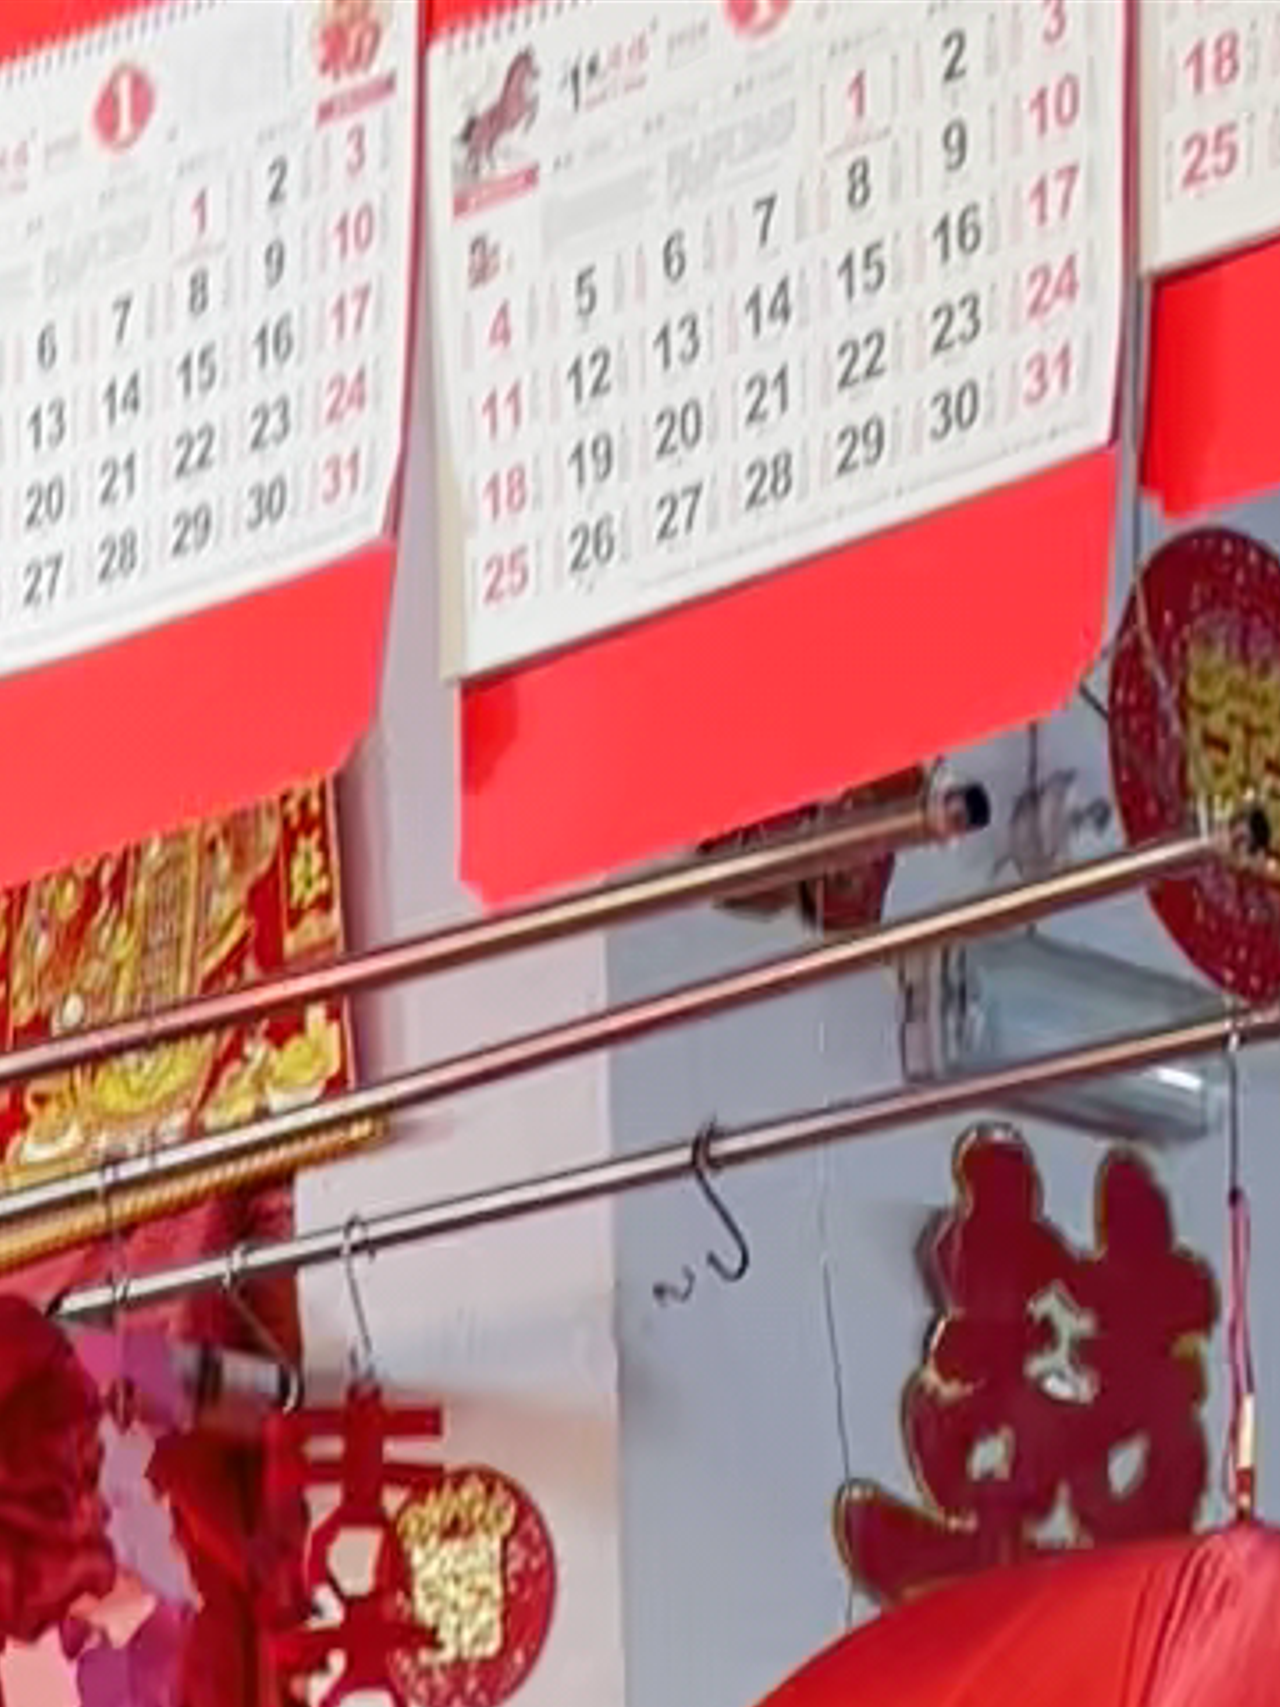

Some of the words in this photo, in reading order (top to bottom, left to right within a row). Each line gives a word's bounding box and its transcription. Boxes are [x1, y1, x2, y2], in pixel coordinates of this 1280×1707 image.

[848, 69, 865, 119] 1
[943, 30, 966, 84] 2
[1043, 0, 1066, 45] 3
[1185, 31, 1240, 95] 18
[192, 188, 206, 235] 1
[268, 156, 287, 208] 2
[347, 124, 366, 179] 3
[489, 300, 511, 349] 4
[576, 265, 597, 323] 5
[663, 231, 686, 283] 6
[754, 194, 777, 247] 7
[847, 157, 870, 210] 8
[942, 119, 967, 172] 9
[1030, 73, 1079, 137] 10
[1182, 122, 1238, 189] 25
[29, 398, 66, 451] 13
[104, 371, 140, 426] 14
[178, 343, 216, 398] 15
[254, 313, 293, 369] 16
[332, 282, 371, 341] 17
[38, 324, 57, 370] 6
[113, 295, 132, 345] 7
[189, 268, 208, 317] 8
[265, 239, 285, 288] 9
[335, 202, 375, 261] 10
[482, 380, 521, 439] 11
[567, 347, 611, 404] 12
[654, 313, 700, 371] 13
[745, 276, 791, 337] 14
[838, 240, 885, 301] 15
[933, 203, 981, 264] 16
[1030, 162, 1079, 226] 17
[26, 476, 64, 530] 20
[100, 451, 135, 505] 21
[175, 423, 215, 479] 22
[250, 395, 290, 452] 23
[326, 365, 366, 424] 24
[485, 464, 527, 522] 18
[569, 433, 613, 490] 19
[656, 399, 702, 459] 20
[746, 363, 788, 426] 21
[838, 329, 885, 392] 22
[932, 292, 981, 356] 23
[1028, 254, 1079, 318] 24
[24, 552, 63, 606] 27
[98, 529, 137, 583] 28
[172, 504, 212, 557] 29
[247, 475, 287, 530] 30
[323, 446, 360, 504] 31
[484, 545, 528, 604] 25
[570, 515, 614, 573] 26
[657, 481, 703, 542] 27
[745, 451, 792, 511] 28
[837, 417, 884, 477] 29
[931, 379, 978, 440] 30
[1025, 341, 1071, 405] 31
